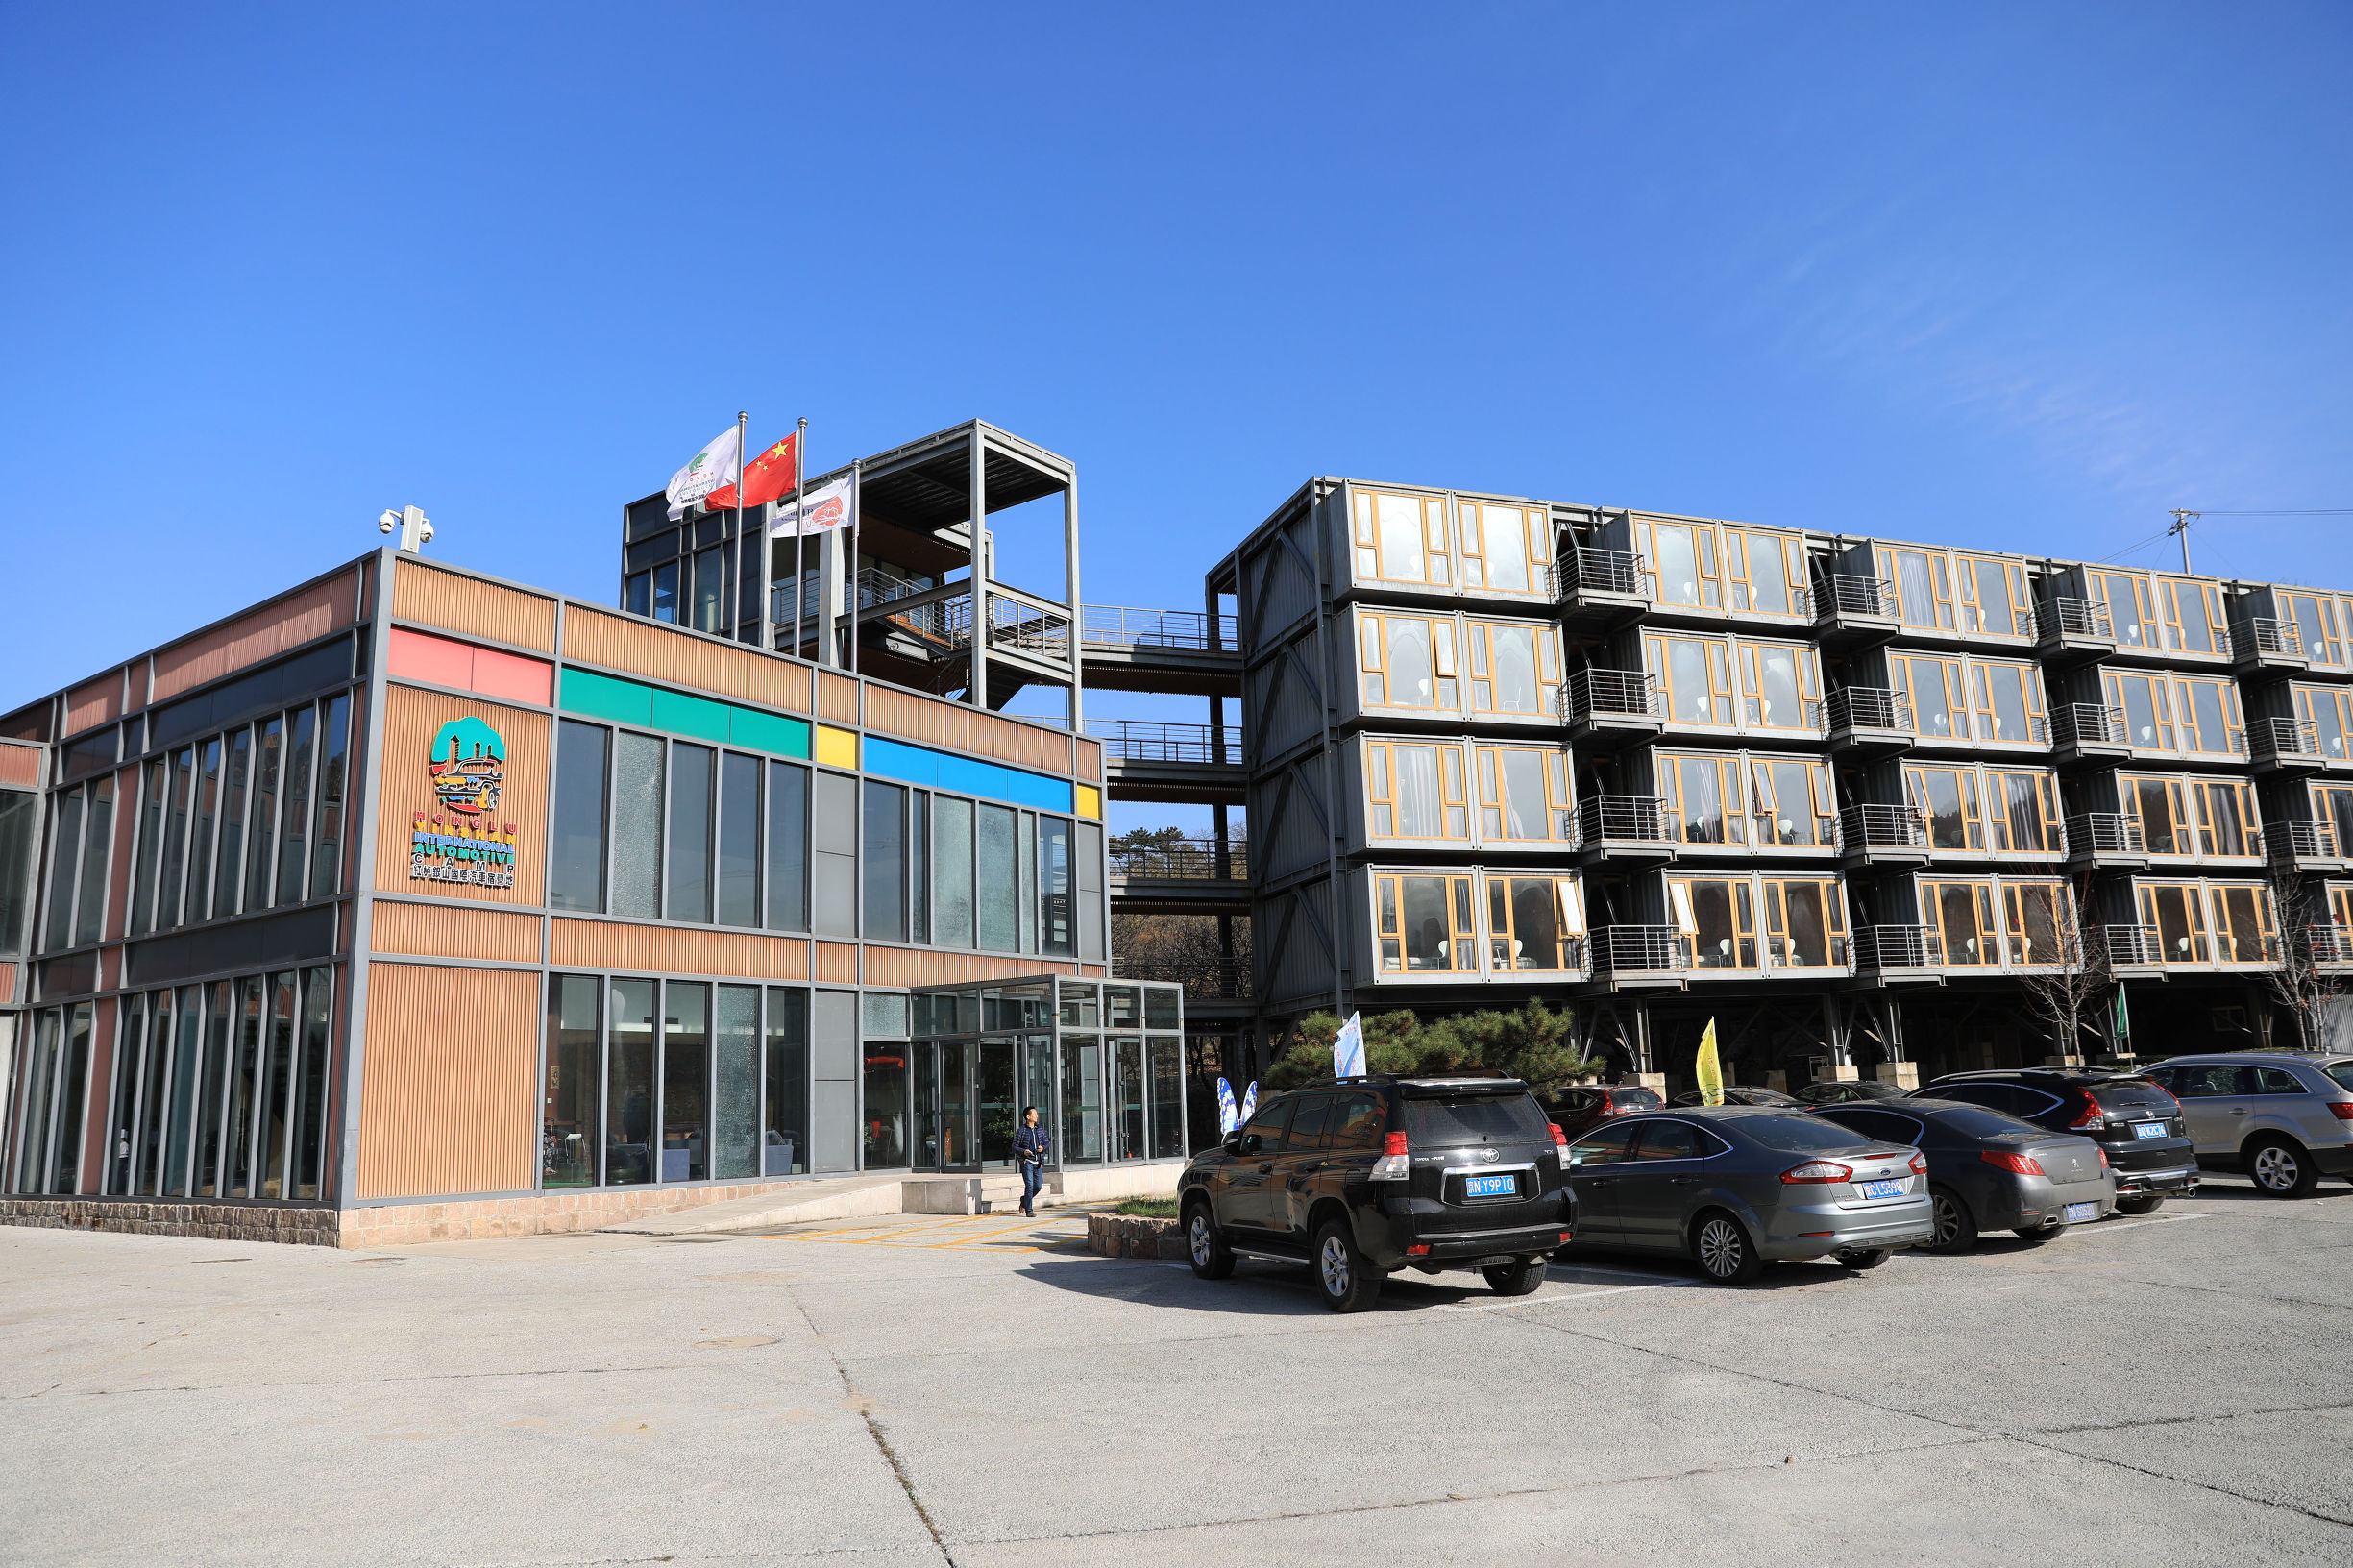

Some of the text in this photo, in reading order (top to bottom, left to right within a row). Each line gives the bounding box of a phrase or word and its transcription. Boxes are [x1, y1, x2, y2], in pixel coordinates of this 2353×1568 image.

[414, 821, 516, 845] YINSHAN
[415, 811, 516, 834] HONGLU
[414, 832, 515, 854] INTERNATIONAL
[414, 843, 515, 864] AUTOMOTIVE
[414, 854, 514, 873] CAMP
